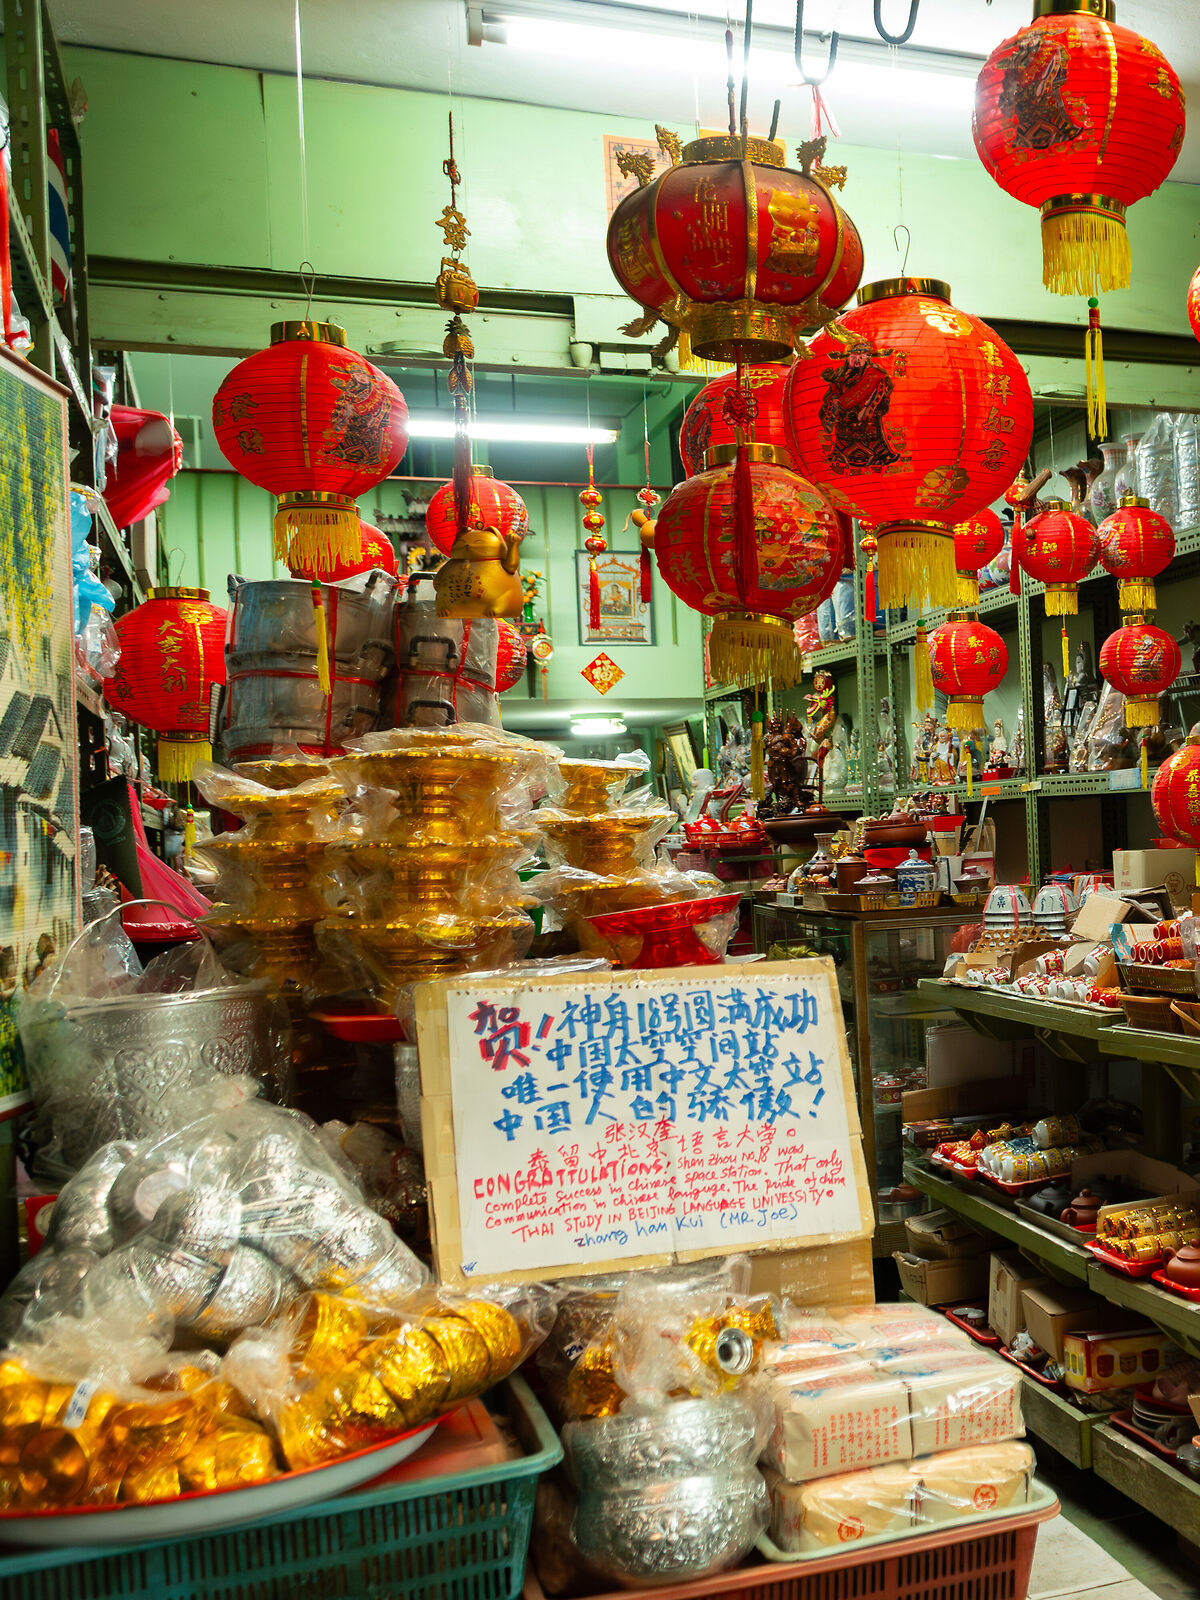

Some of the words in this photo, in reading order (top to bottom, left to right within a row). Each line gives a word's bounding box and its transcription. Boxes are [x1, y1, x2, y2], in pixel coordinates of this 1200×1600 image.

[976, 340, 1016, 472] 吉祥如意
[665, 502, 705, 592] 吉祥
[155, 619, 189, 693] 大吉大利
[608, 1184, 622, 1194] in
[684, 1170, 719, 1190] space
[774, 1154, 816, 1177] That
[815, 1149, 843, 1175] only
[777, 1143, 805, 1158] was
[593, 1199, 607, 1209] in
[732, 1179, 759, 1195] The
[803, 1171, 816, 1190] of
[511, 1223, 554, 1243] THAI
[608, 1213, 622, 1224] IN
[628, 1203, 676, 1222] BEIJING
